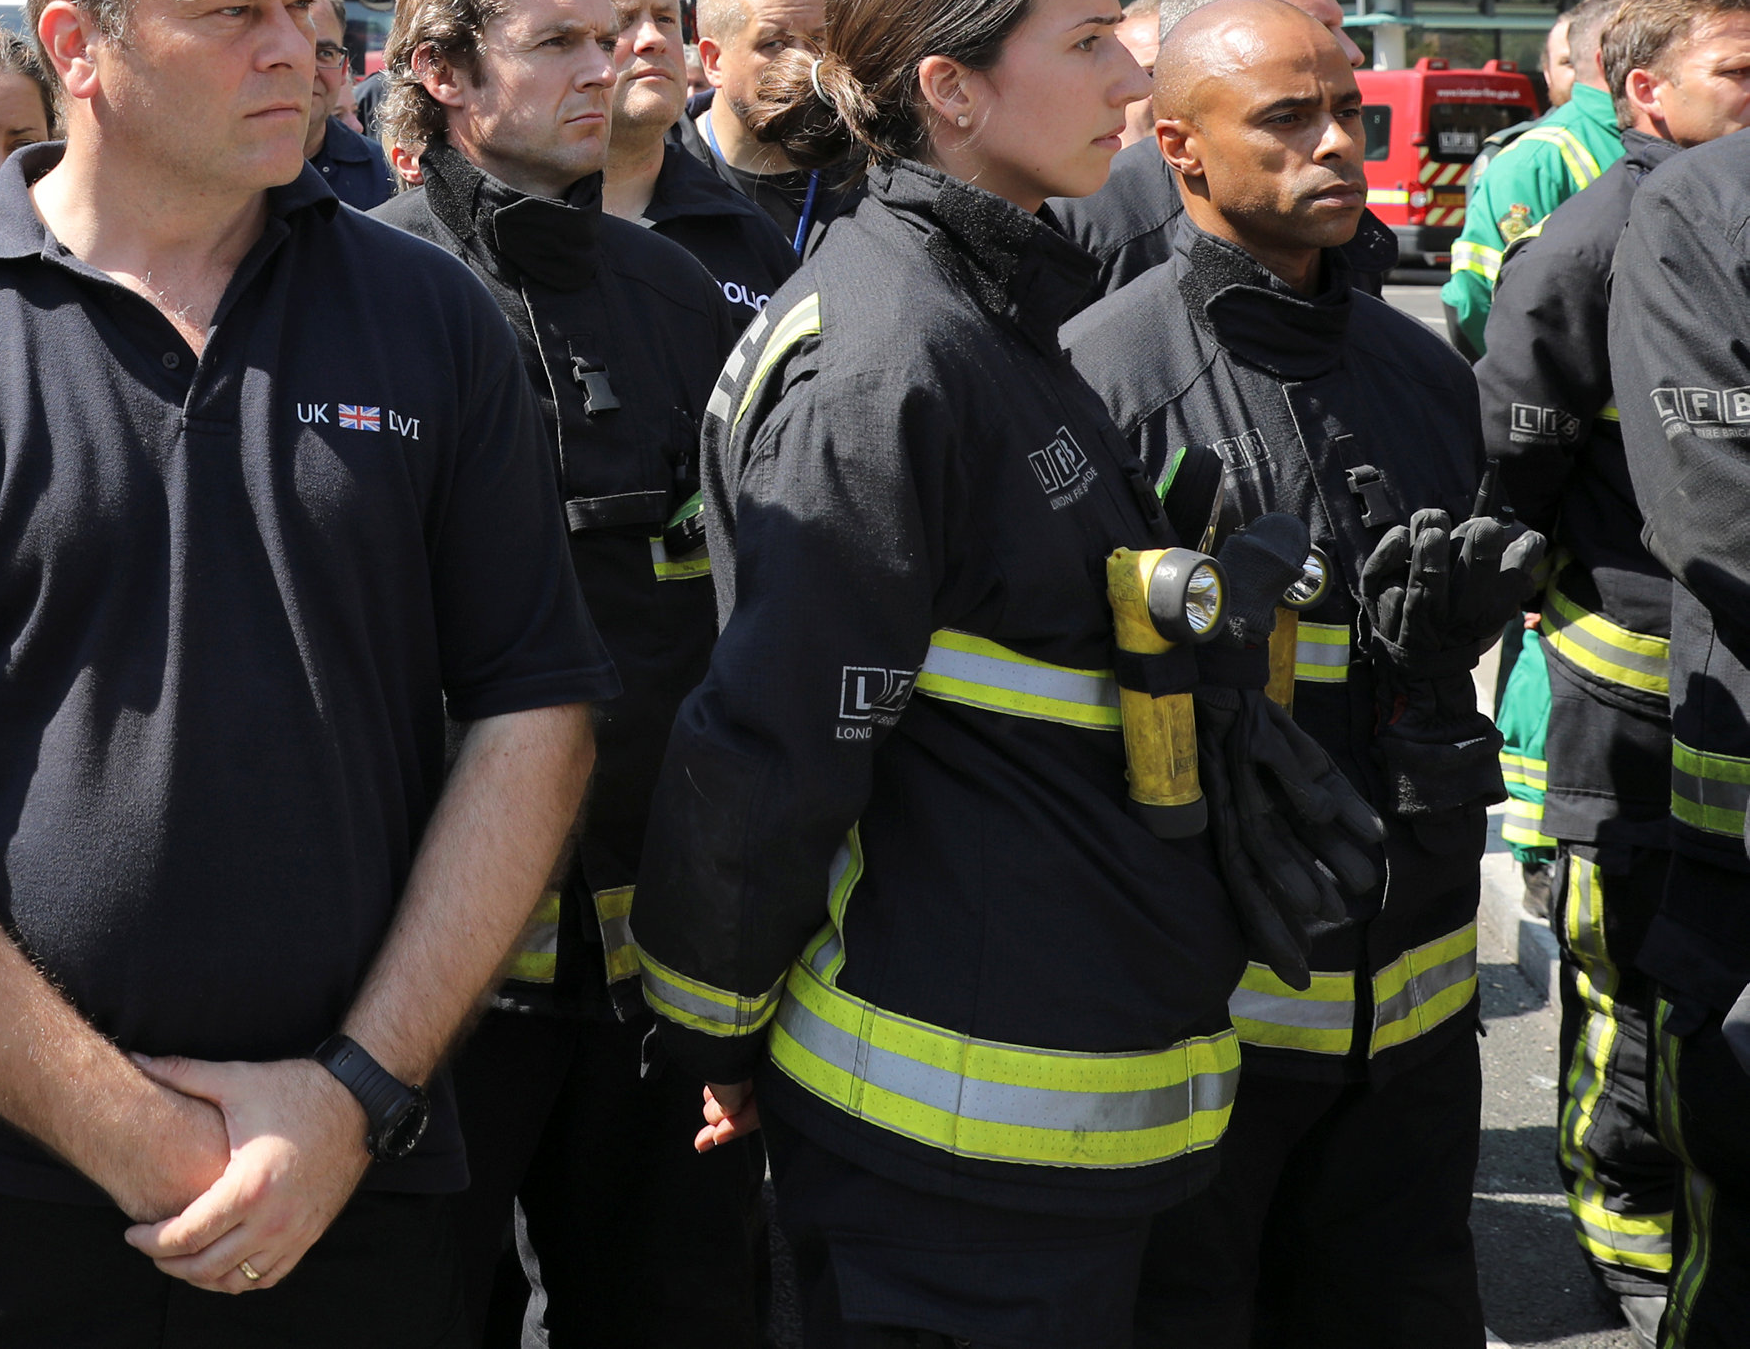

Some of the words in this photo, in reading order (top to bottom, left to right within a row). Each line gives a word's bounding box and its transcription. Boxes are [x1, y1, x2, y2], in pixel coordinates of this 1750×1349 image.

[1374, 115, 1381, 124] 8
[716, 281, 770, 312] OLIC
[297, 403, 329, 424] UK
[1722, 428, 1750, 438] BRIG
